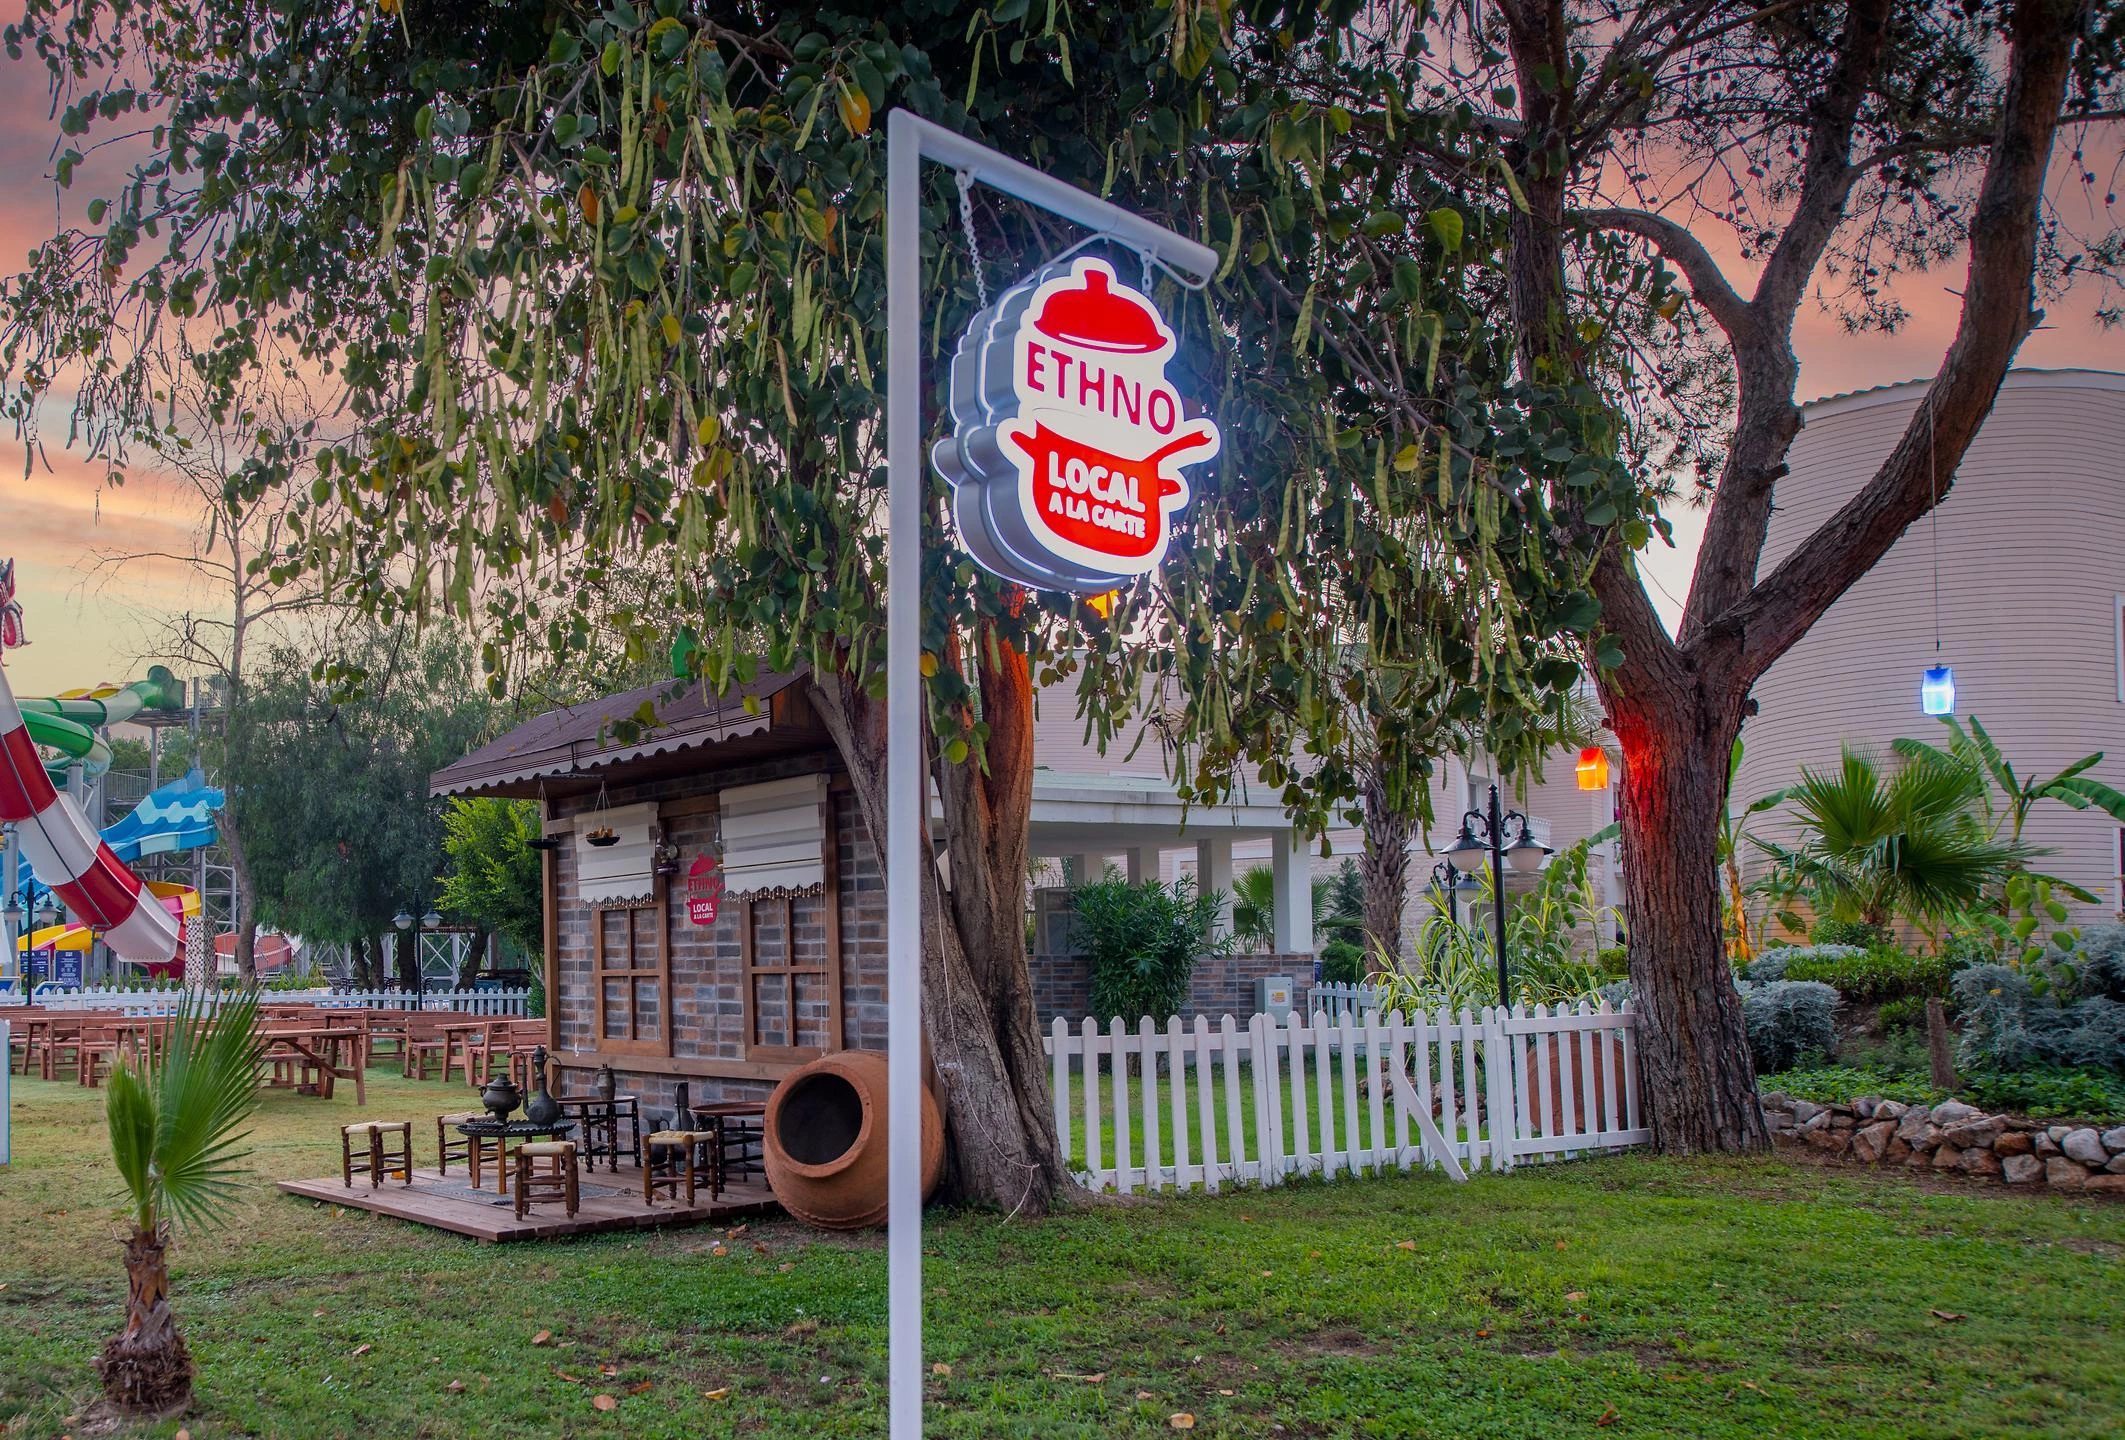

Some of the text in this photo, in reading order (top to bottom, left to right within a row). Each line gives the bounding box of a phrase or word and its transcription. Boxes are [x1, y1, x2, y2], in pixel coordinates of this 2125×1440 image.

[1027, 340, 1175, 434] ETHNO
[1048, 451, 1145, 512] LOCAL
[1048, 492, 1145, 538] A LA CARTE
[693, 903, 713, 913] LOCAL
